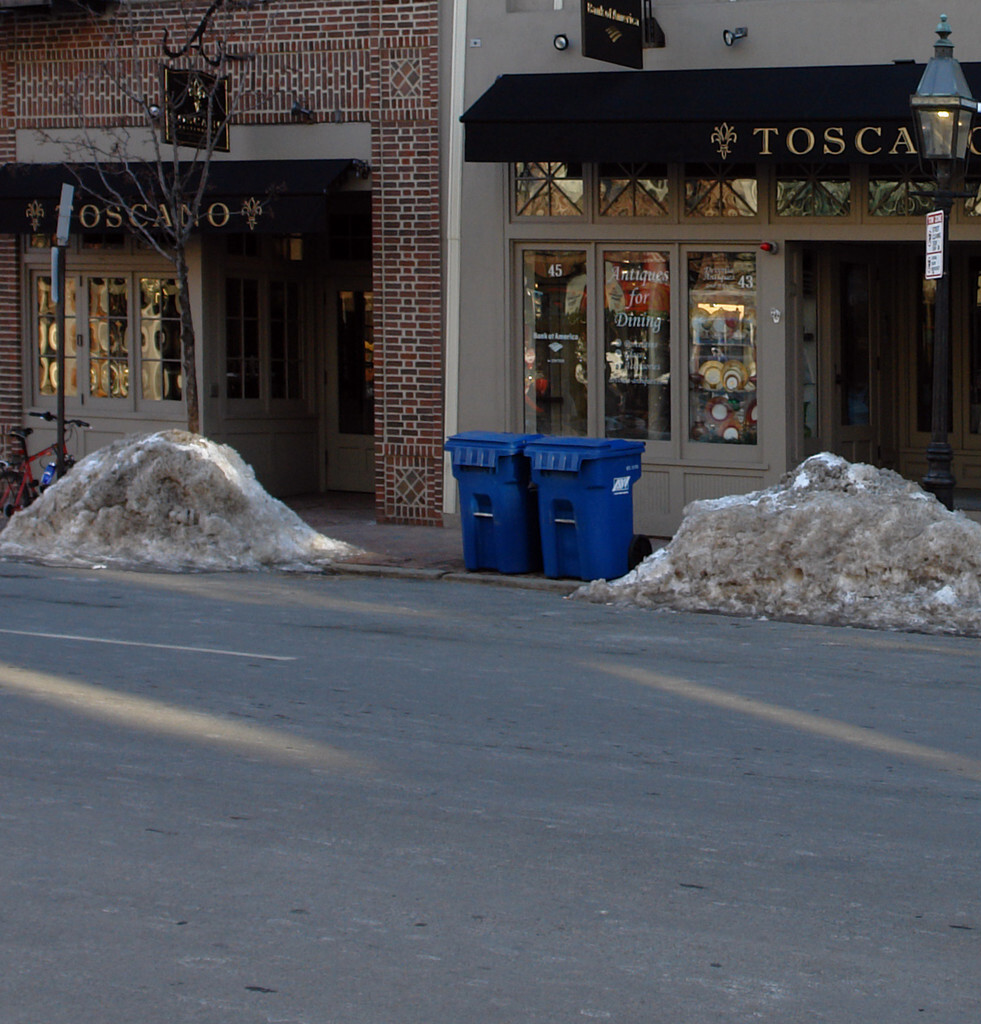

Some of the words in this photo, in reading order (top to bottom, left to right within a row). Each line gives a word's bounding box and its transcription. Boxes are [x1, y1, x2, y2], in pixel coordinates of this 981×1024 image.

[56, 203, 230, 228] OSCANO
[548, 264, 563, 277] 45
[607, 265, 669, 286] Antiques
[737, 275, 753, 289] 43
[625, 287, 650, 309] for
[614, 312, 662, 333] Dining
[533, 332, 548, 340] Bank
[555, 332, 579, 340] America
